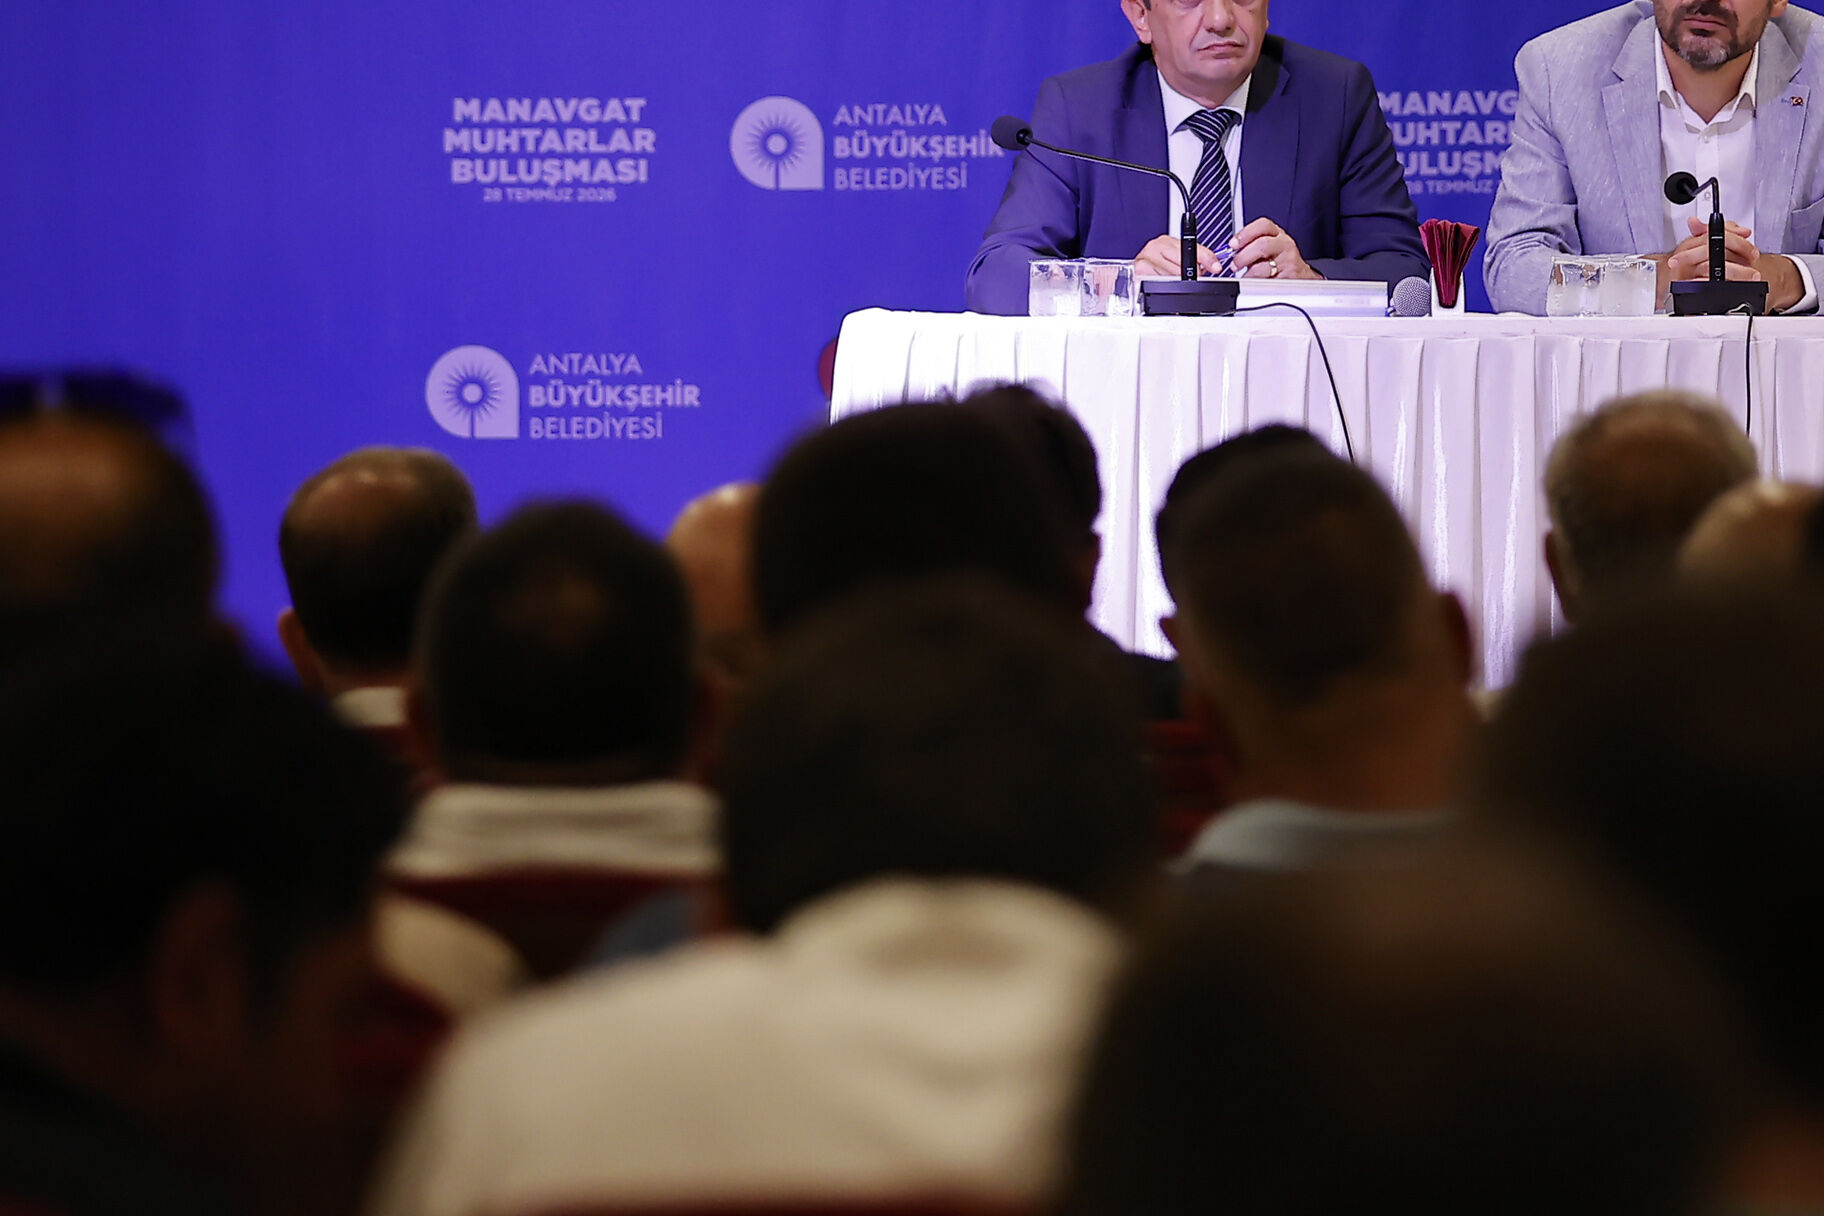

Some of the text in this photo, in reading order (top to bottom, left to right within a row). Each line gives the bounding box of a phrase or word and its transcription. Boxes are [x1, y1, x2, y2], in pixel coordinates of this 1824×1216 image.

[454, 98, 646, 122] MANAVGAT
[833, 104, 947, 126] ANTALYA
[1378, 90, 1518, 115] MANAVG
[444, 128, 655, 153] MUHTARLAR
[1388, 120, 1512, 145] UHTAR
[452, 158, 647, 186] BULUŞMASI
[834, 161, 967, 190] BELEDİYESİ
[530, 353, 642, 375] ANTALYA
[530, 379, 700, 412] BÜYÜKŞEHİR
[530, 411, 662, 439] BELEDİYESİ
